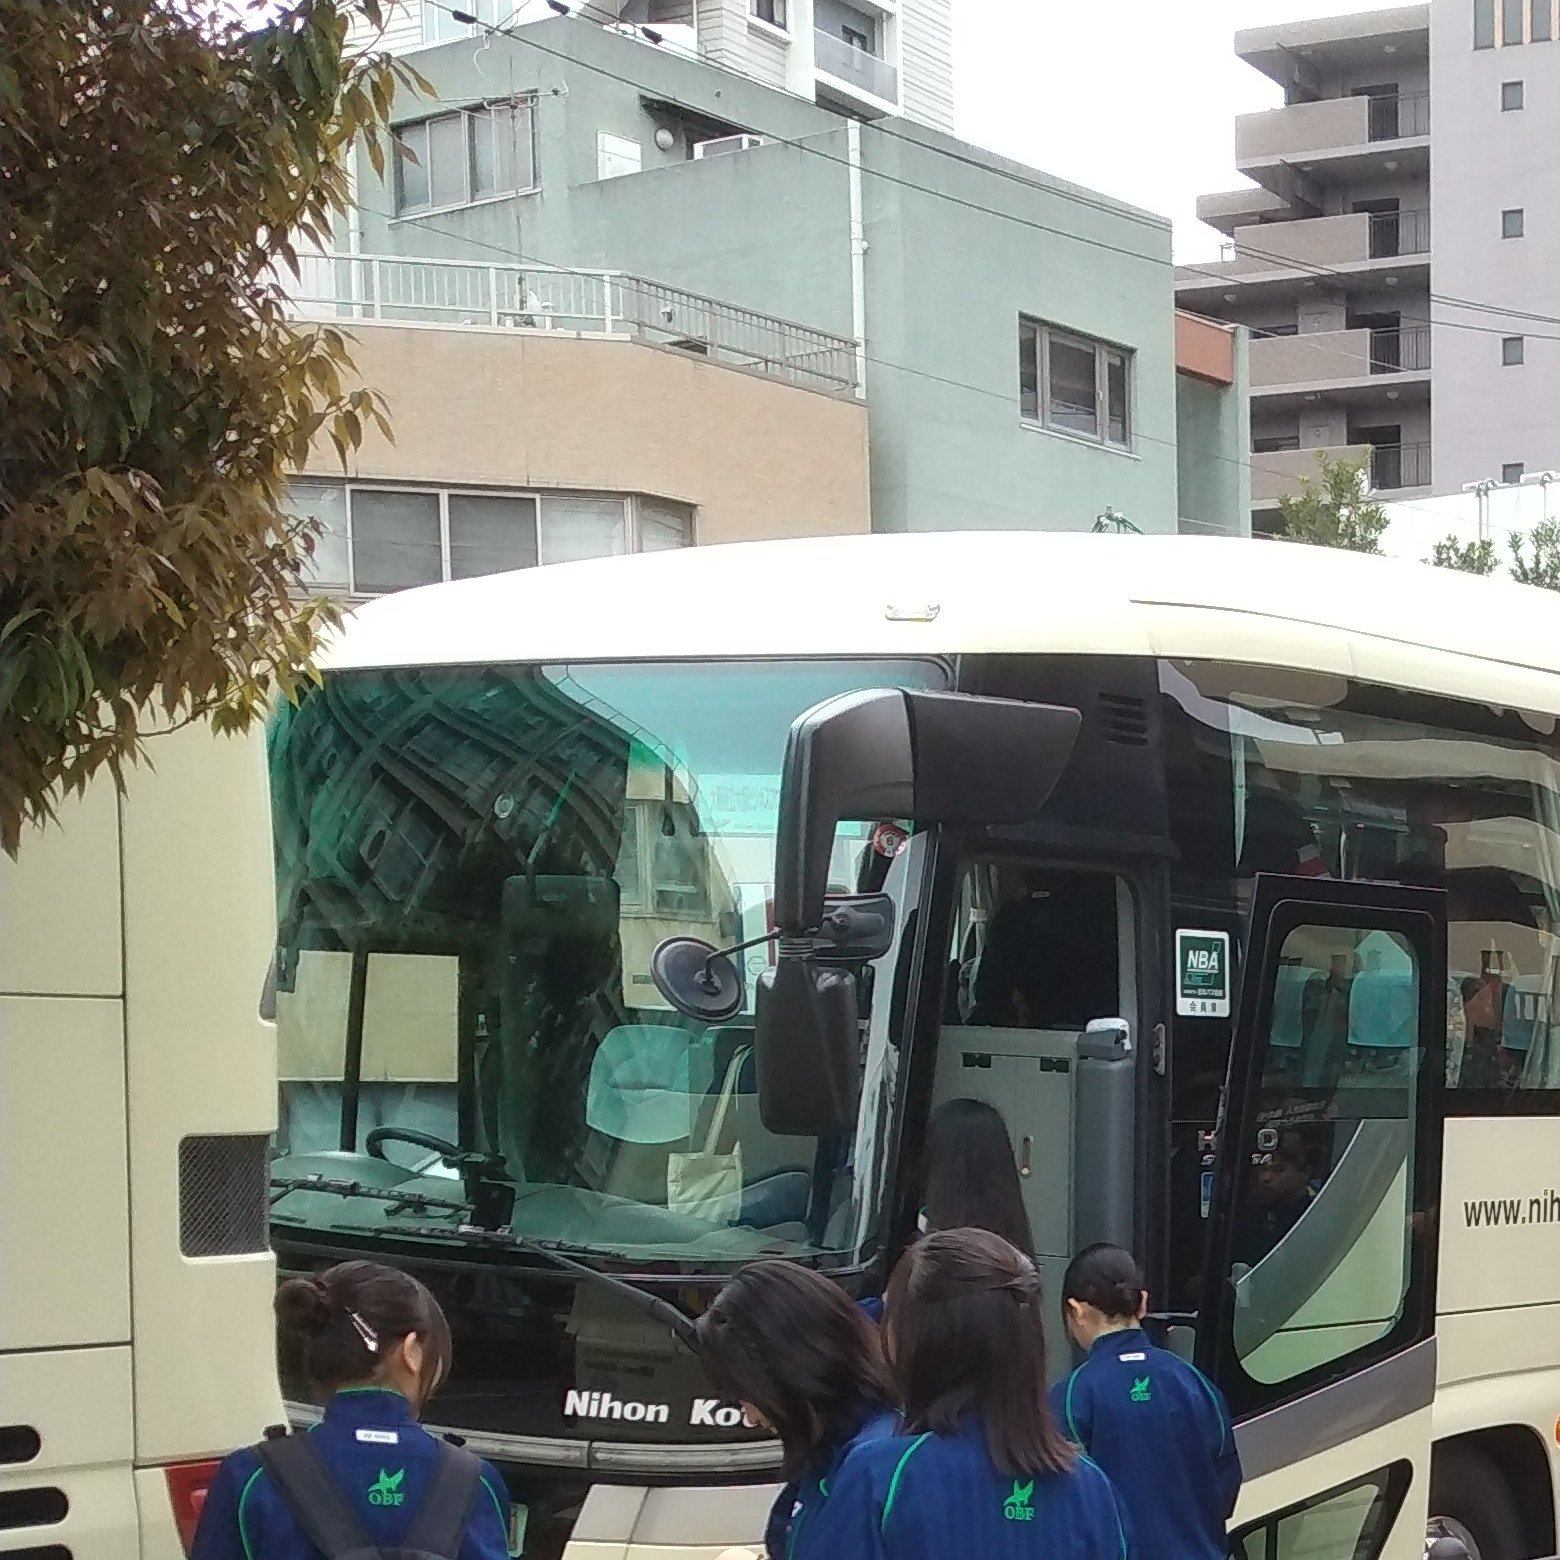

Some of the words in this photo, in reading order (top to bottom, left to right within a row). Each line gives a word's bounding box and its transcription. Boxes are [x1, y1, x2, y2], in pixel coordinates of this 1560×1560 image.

[1187, 949, 1219, 970] NBA
[564, 1389, 670, 1423] Nihon
[689, 1398, 759, 1428] Ko
[368, 1491, 404, 1506] OBF
[1004, 1505, 1035, 1520] OBF
